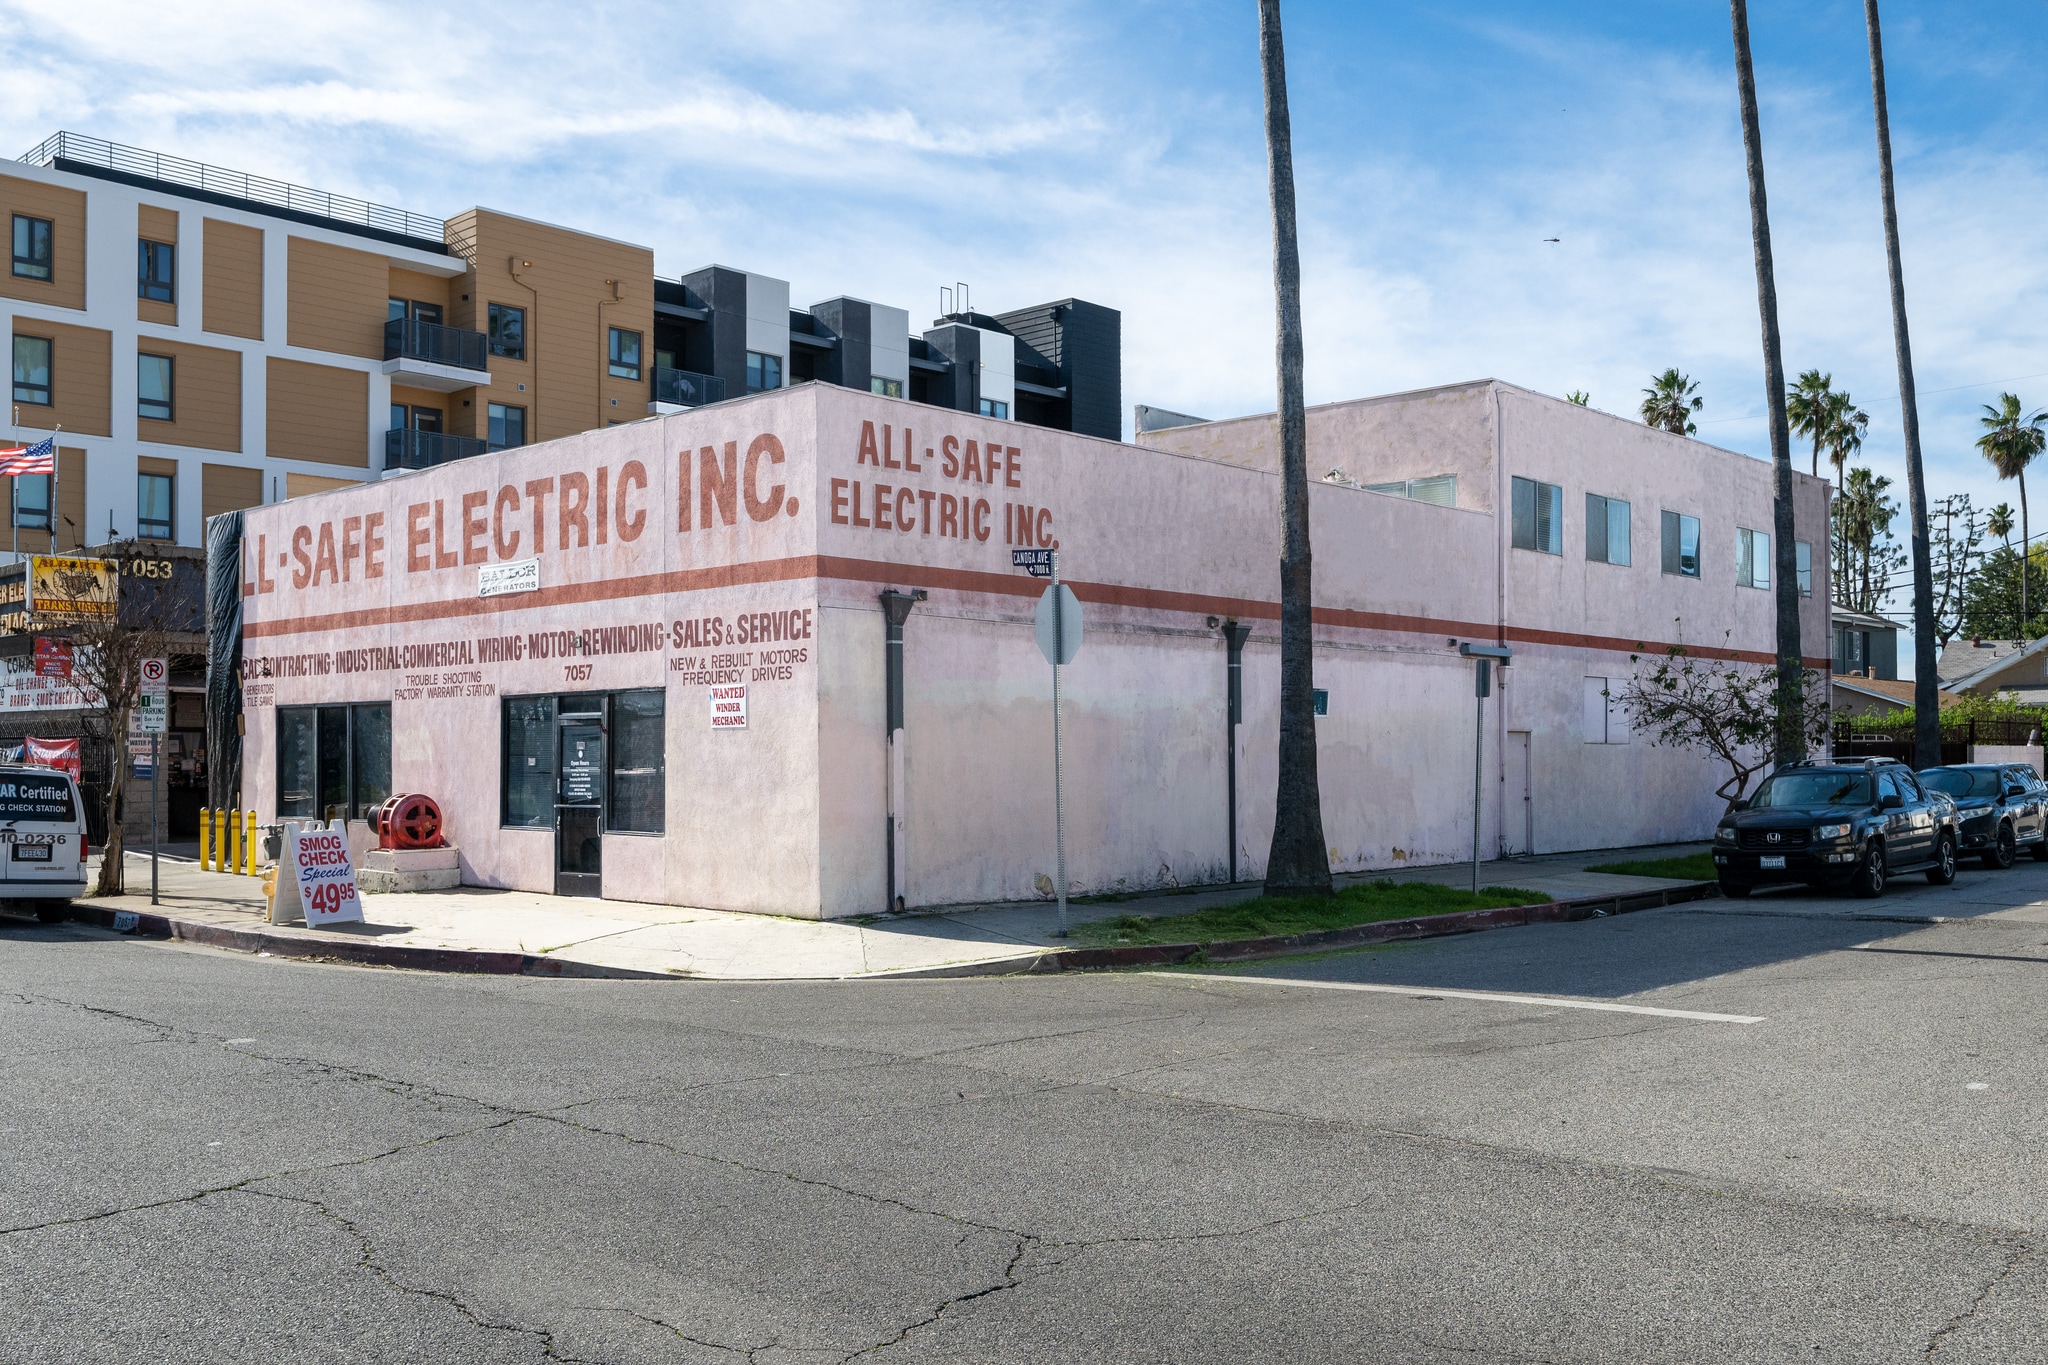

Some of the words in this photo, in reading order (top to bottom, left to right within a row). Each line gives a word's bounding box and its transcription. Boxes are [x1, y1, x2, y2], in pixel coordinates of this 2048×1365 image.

[857, 419, 1021, 488] ALL-SAFE
[407, 459, 648, 573] ELECTRIC
[678, 432, 800, 533] INC.
[831, 477, 991, 542] ELECTRIC
[1006, 502, 1060, 550] INC.
[1013, 552, 1036, 564] CANOGA
[8, 581, 27, 602] ELE
[725, 623, 735, 645] &
[737, 608, 812, 645] SERVICE
[670, 656, 697, 671] NEW
[699, 657, 706, 670] &
[711, 652, 753, 669] REBUILT
[760, 647, 808, 666] MOTORS
[405, 673, 439, 688] TROUBLE
[442, 670, 482, 685] SHOOTING
[564, 663, 593, 682] 7057
[682, 669, 745, 686] FREQUENCY
[752, 666, 793, 682] DRIVES
[16, 678, 24, 691] OIL
[26, 676, 48, 690] CHANGE
[394, 688, 424, 701] FACTORY
[427, 685, 464, 699] WARRANTY
[466, 683, 496, 698] STATION
[10, 694, 30, 707] BRAKES
[36, 692, 53, 706] SMOG
[54, 690, 73, 705] CHECK
[152, 696, 165, 704] HOUR
[712, 686, 745, 700] WANTED
[247, 697, 258, 708] TILE
[716, 702, 741, 712] WINDER
[712, 715, 746, 726] MECHANIC
[0, 783, 17, 798] AR
[20, 785, 68, 801] Certified
[8, 804, 34, 812] CHECK
[36, 805, 67, 813] STATION
[299, 835, 342, 852] SMOG
[298, 850, 349, 867] CHECK
[301, 864, 350, 882] Special
